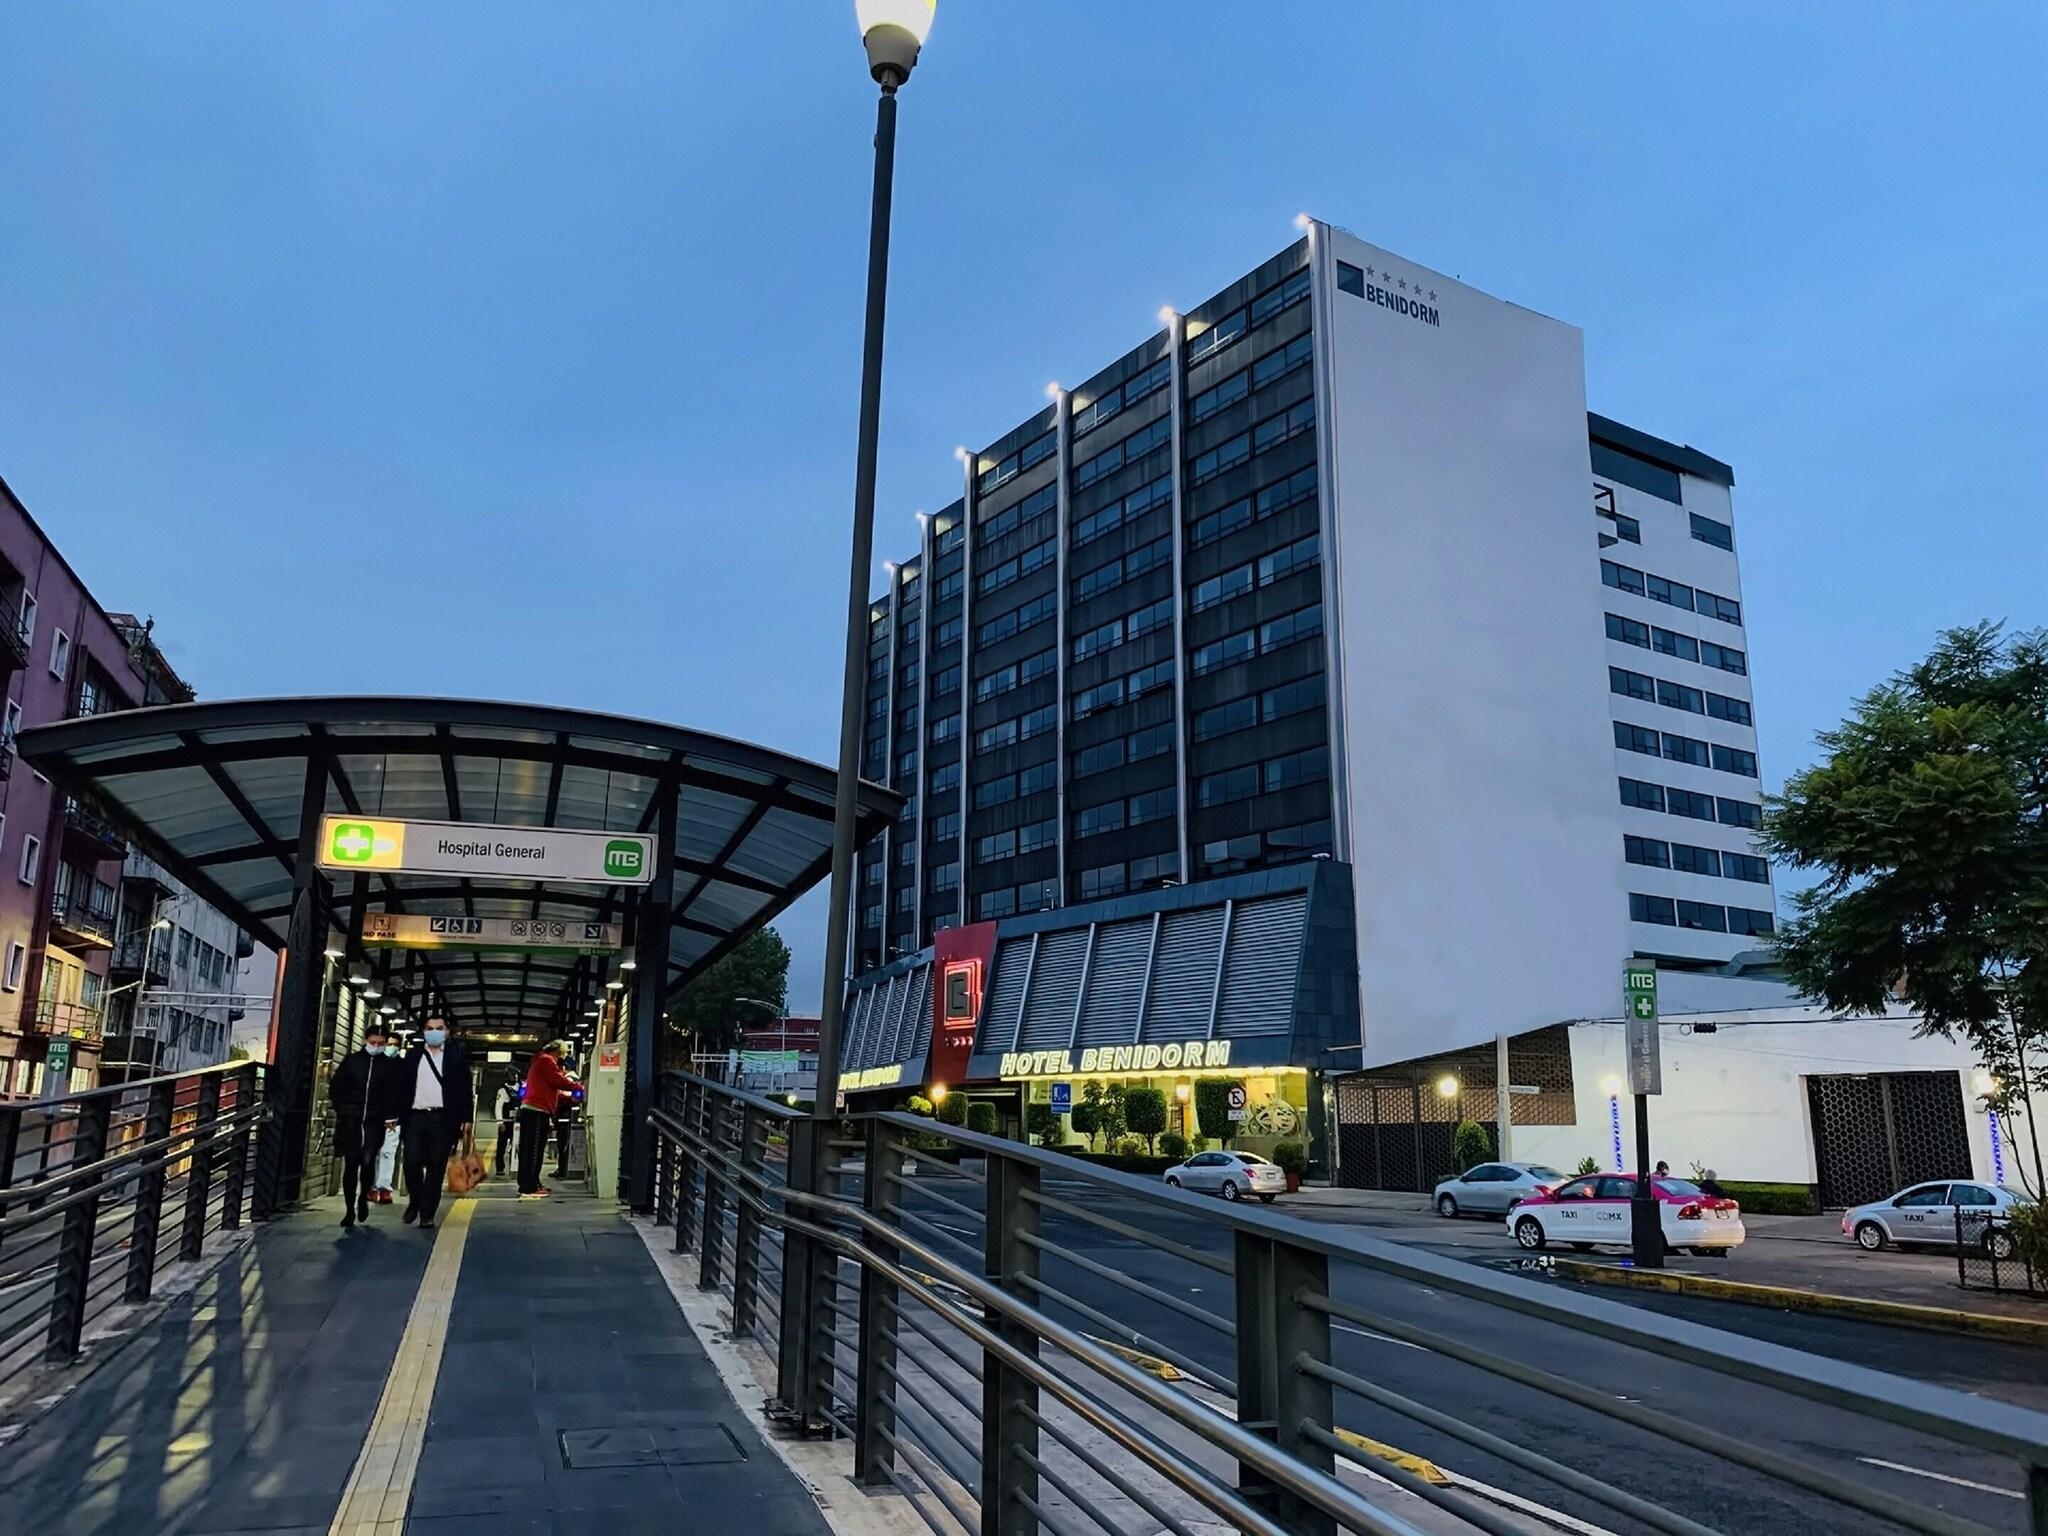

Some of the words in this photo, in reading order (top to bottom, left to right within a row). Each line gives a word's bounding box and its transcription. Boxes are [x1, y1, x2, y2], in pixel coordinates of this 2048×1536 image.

[1367, 283, 1440, 327] BENIDORM
[437, 839, 492, 858] Hospital
[495, 843, 546, 860] General
[999, 1050, 1074, 1076] HOTEL
[1080, 1039, 1232, 1072] BENIDORM
[1560, 1210, 1578, 1219] TAXI
[1596, 1211, 1622, 1221] CDMX
[1903, 1214, 1924, 1222] TAXI
